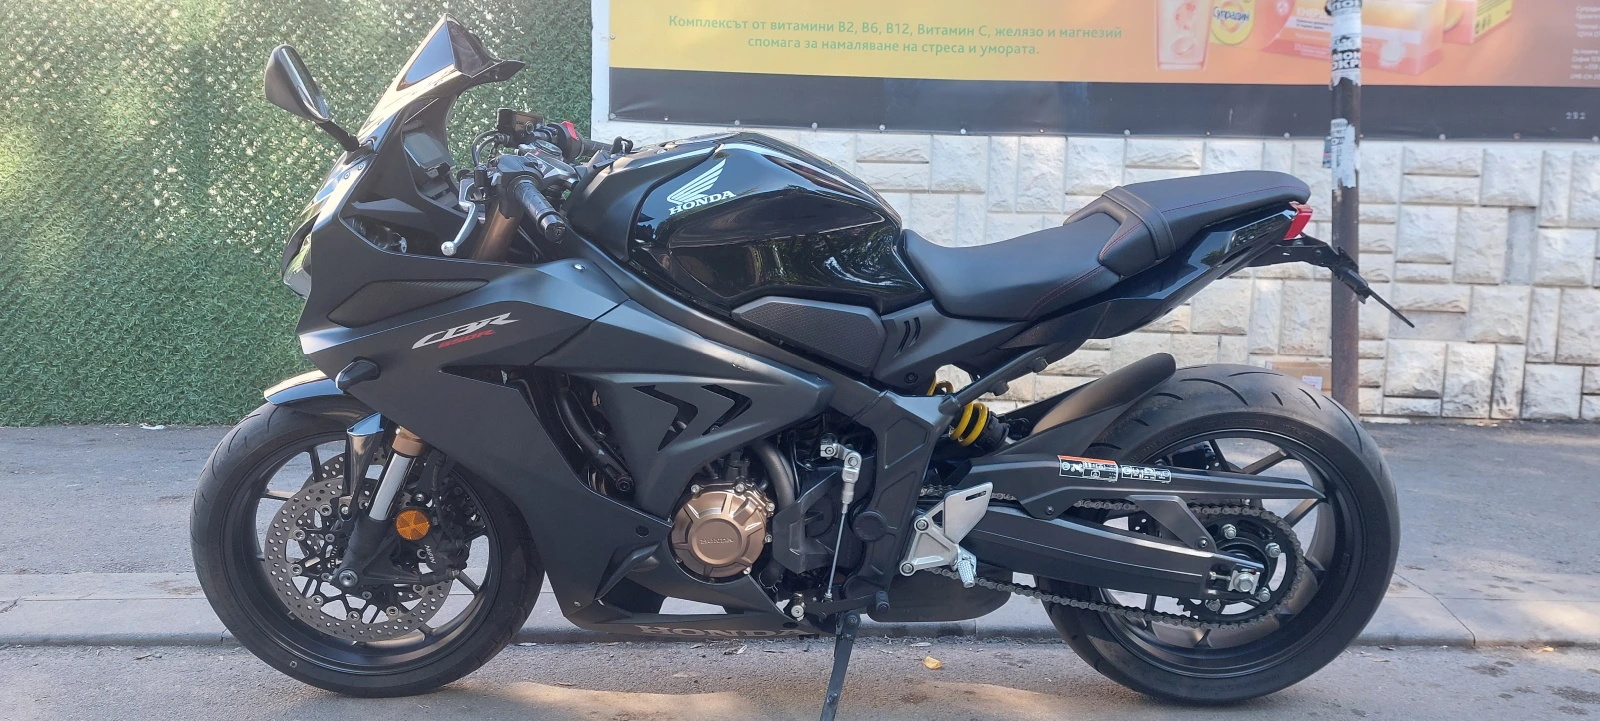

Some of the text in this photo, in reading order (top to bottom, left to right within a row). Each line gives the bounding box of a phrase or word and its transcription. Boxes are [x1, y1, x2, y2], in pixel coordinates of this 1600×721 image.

[669, 15, 748, 29] Комплексът
[752, 21, 766, 30] от
[770, 22, 834, 32] витамини
[918, 23, 974, 37] Витамин
[995, 27, 1043, 38] желязо
[1048, 28, 1056, 37] и
[1060, 26, 1122, 38] магнезий
[748, 36, 1040, 57] спомага за намаляване на стреса и умората.
[668, 190, 736, 215] HONDA
[412, 312, 520, 349] CBR
[634, 624, 815, 637] HONDA
